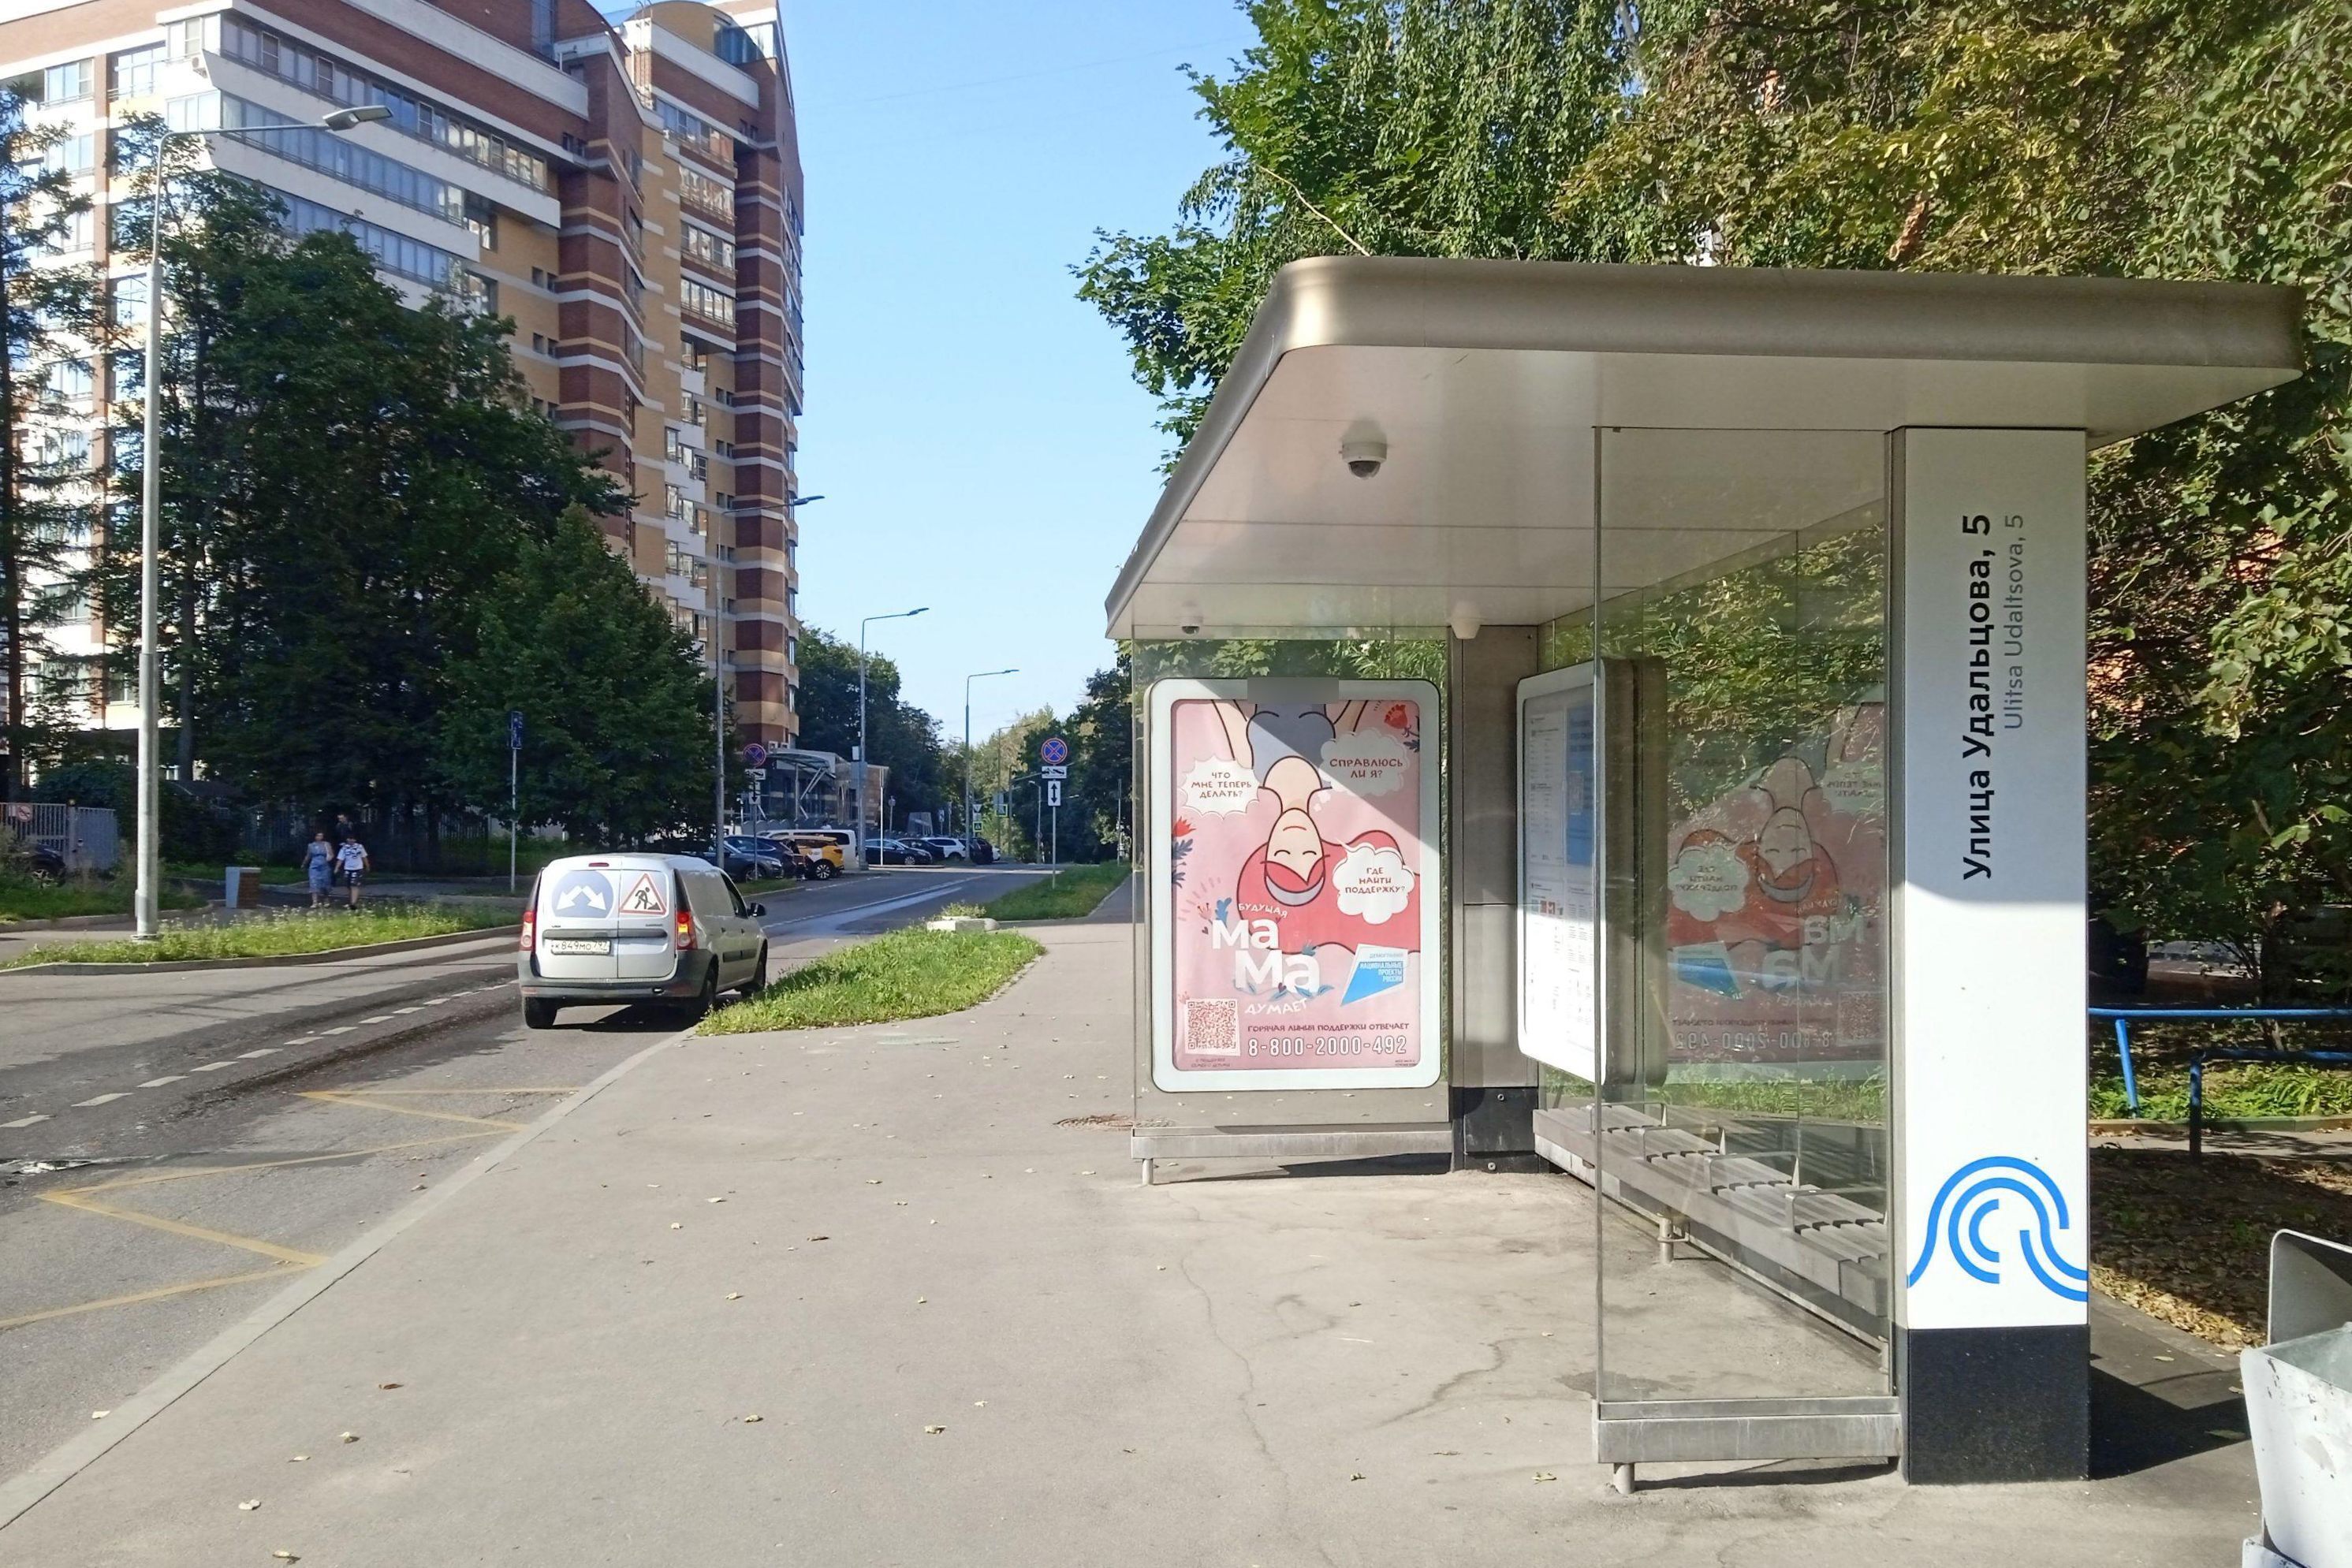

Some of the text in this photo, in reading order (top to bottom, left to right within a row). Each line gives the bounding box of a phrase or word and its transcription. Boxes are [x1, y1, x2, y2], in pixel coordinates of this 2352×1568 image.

[2003, 514, 2026, 729] Ulitsa Udaltsova, 5
[1962, 514, 1996, 880] Улица Удальцова, 5
[1329, 758, 1403, 767] СПРАВЛЮСЬ
[1351, 769, 1383, 778] ЛИ Я?
[1199, 790, 1243, 799] ДЕЛАТЬ?
[1238, 903, 1288, 918] БУДУЩАЯ
[1245, 998, 1309, 1015] ДУМАЕТ
[1318, 1023, 1366, 1032] ПОДДЕРЖКИ
[1247, 1035, 1407, 1057] 8-800-2000-492
